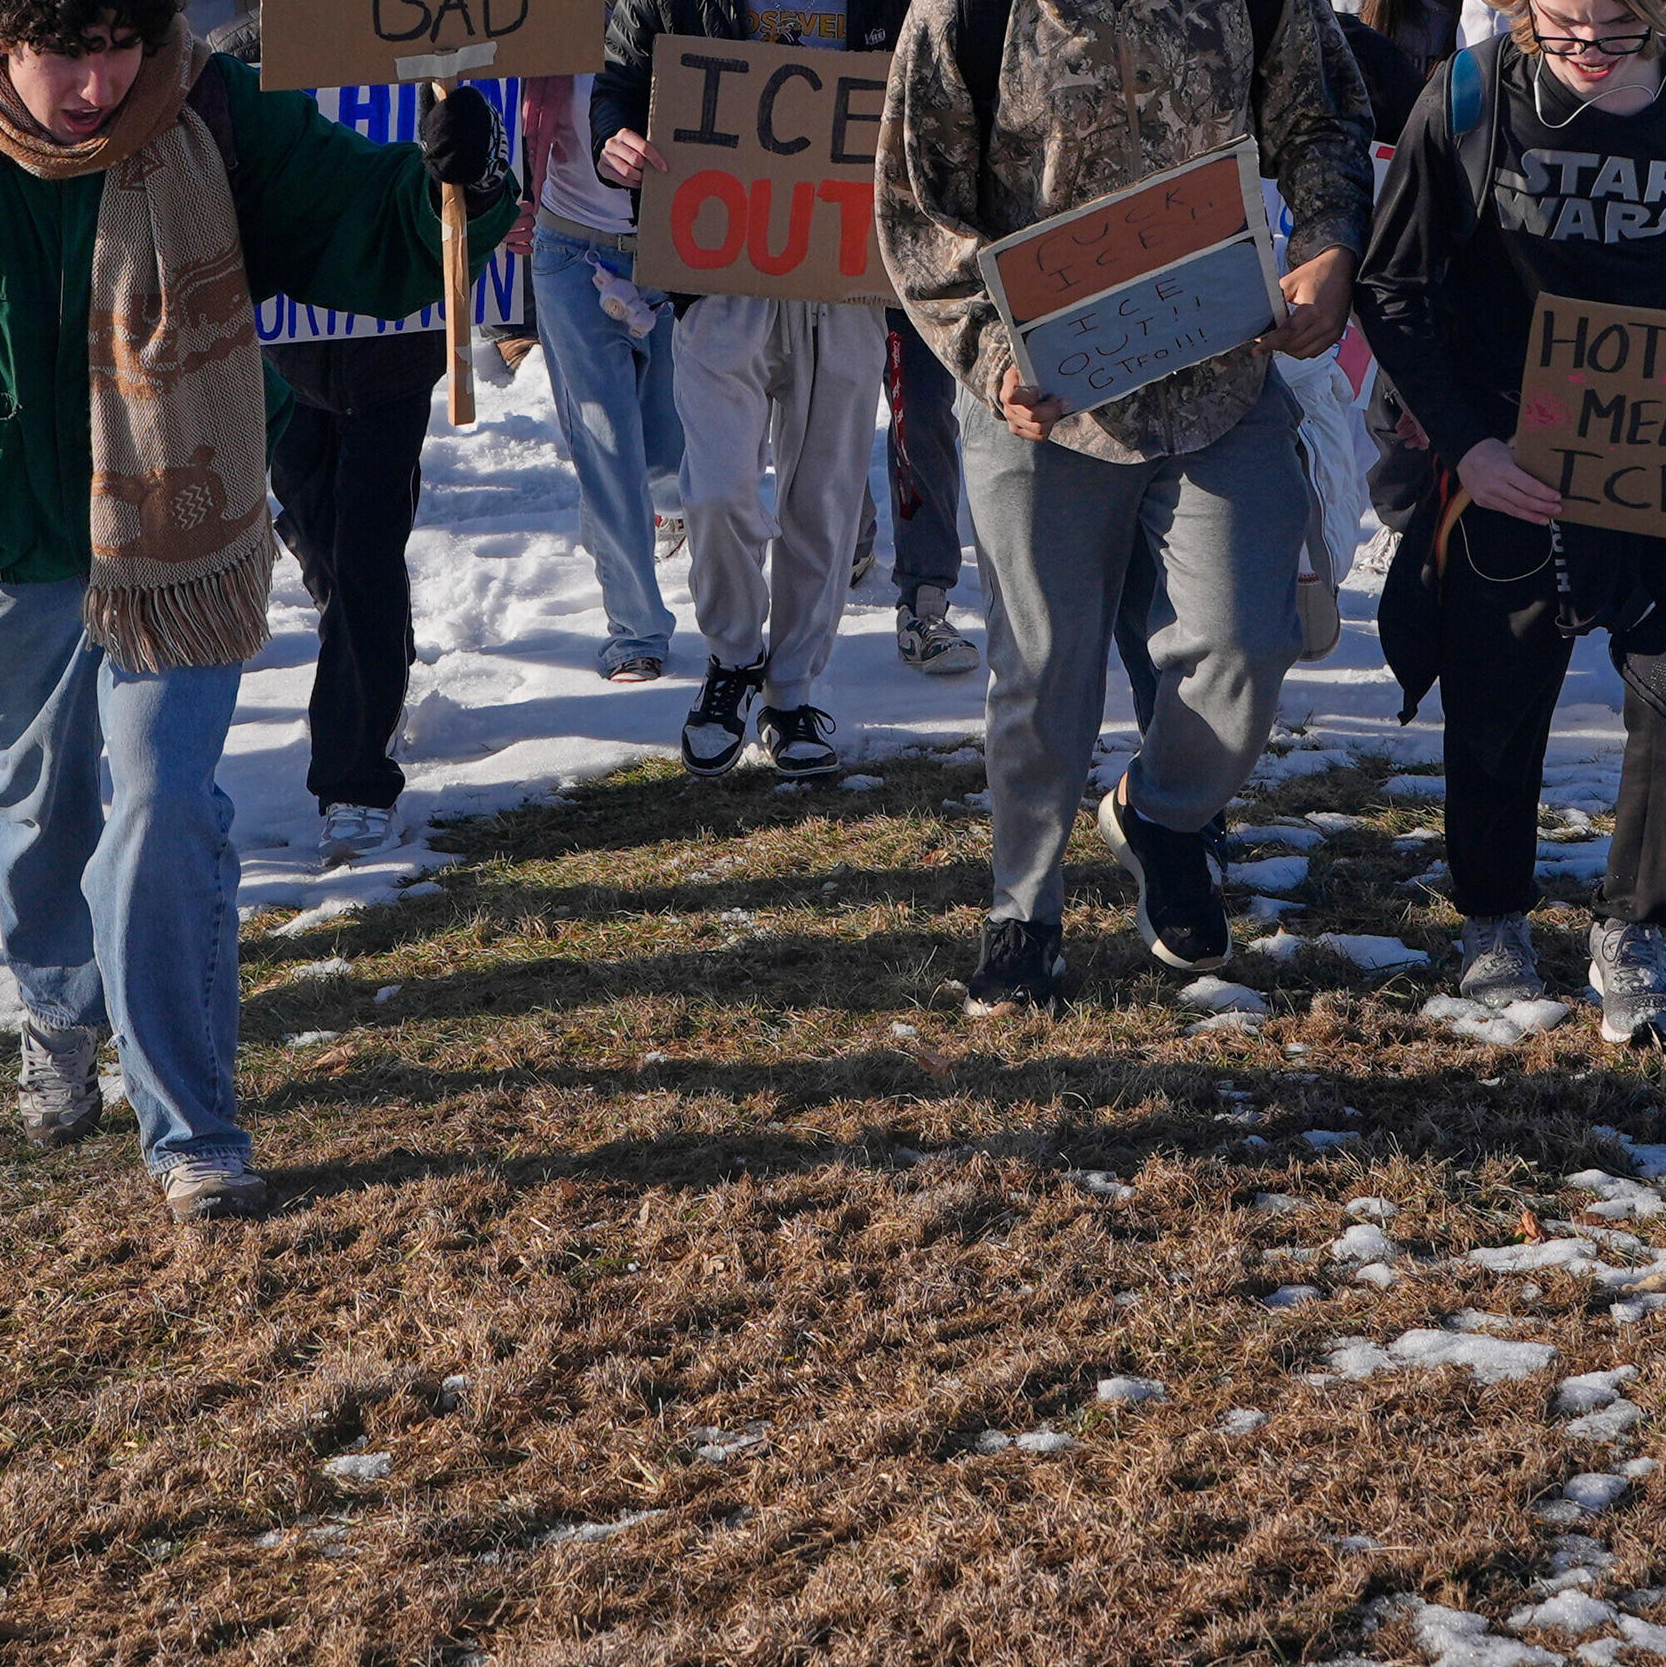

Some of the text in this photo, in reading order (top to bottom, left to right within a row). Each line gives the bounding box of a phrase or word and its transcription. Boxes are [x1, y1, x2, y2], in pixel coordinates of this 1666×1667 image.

[673, 53, 887, 165] ICE
[670, 169, 876, 277] OUT
[1068, 277, 1184, 337] ICE
